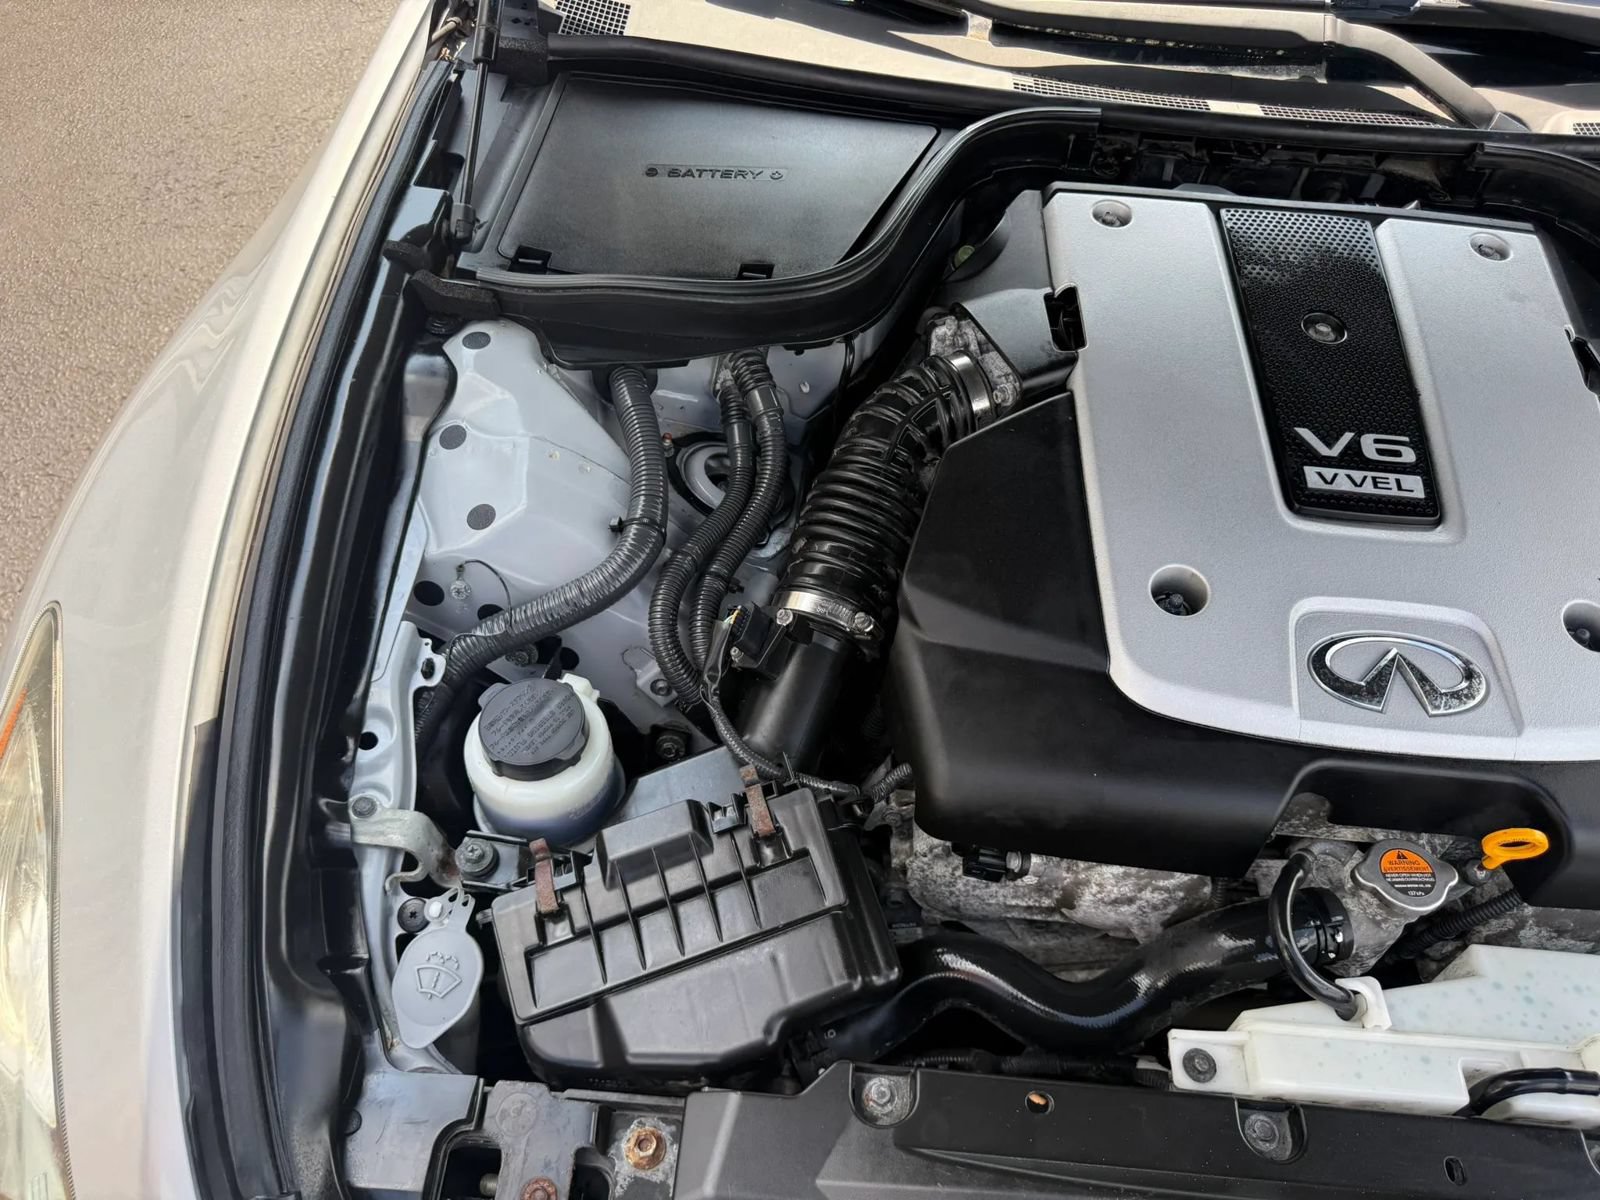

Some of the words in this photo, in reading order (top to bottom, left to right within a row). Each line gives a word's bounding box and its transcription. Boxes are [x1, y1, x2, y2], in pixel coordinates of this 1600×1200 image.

[667, 168, 764, 180] BATTERY
[1293, 427, 1417, 463] V6
[1315, 471, 1415, 493] VVEL
